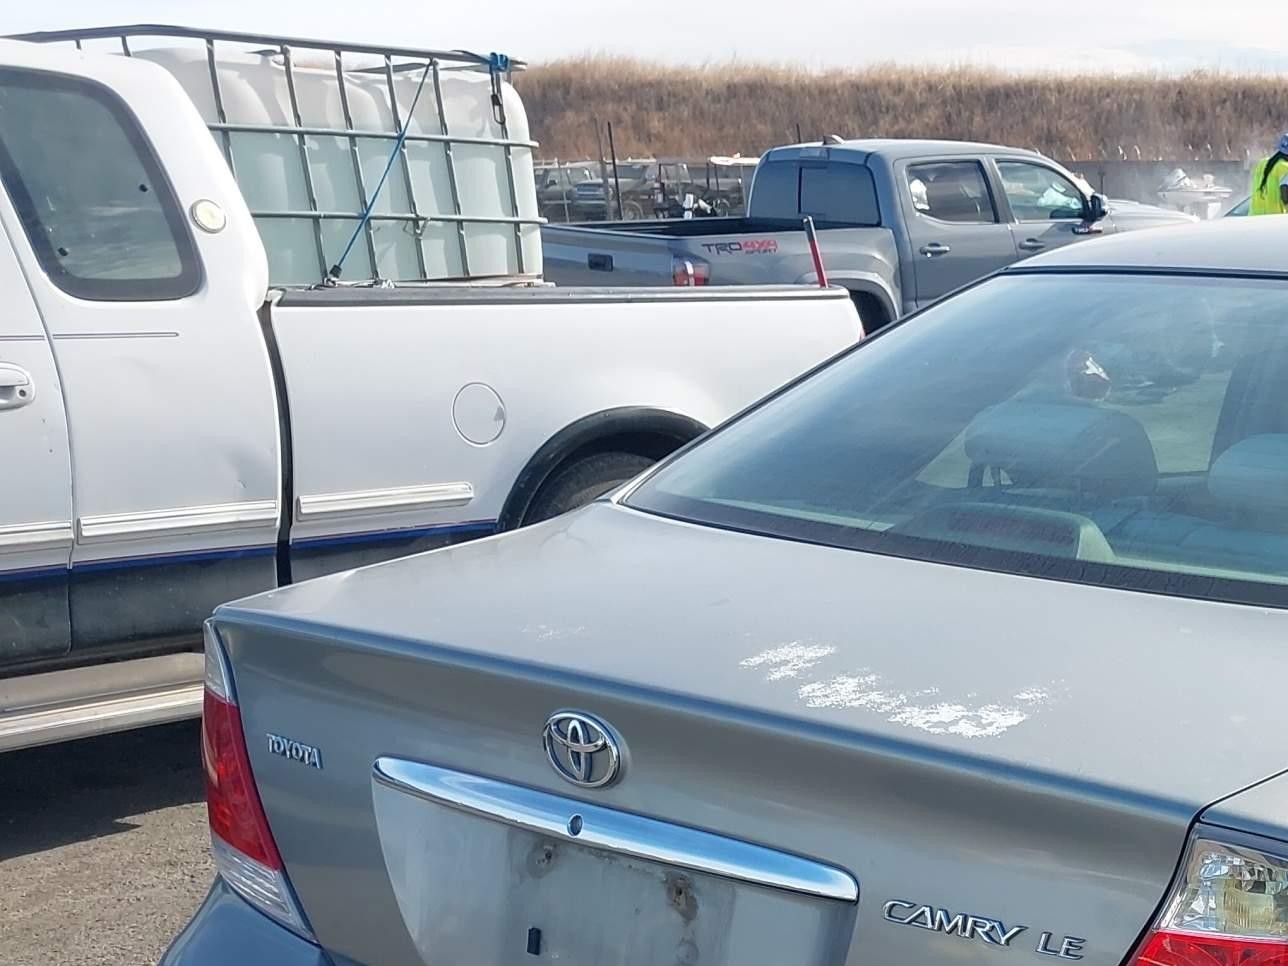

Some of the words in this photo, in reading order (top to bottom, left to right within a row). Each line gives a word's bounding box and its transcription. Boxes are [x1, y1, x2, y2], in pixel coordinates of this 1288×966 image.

[701, 241, 743, 255] TRD
[265, 733, 323, 769] TOYOTA
[883, 899, 1029, 946] CAMRY
[1036, 931, 1087, 961] LE
